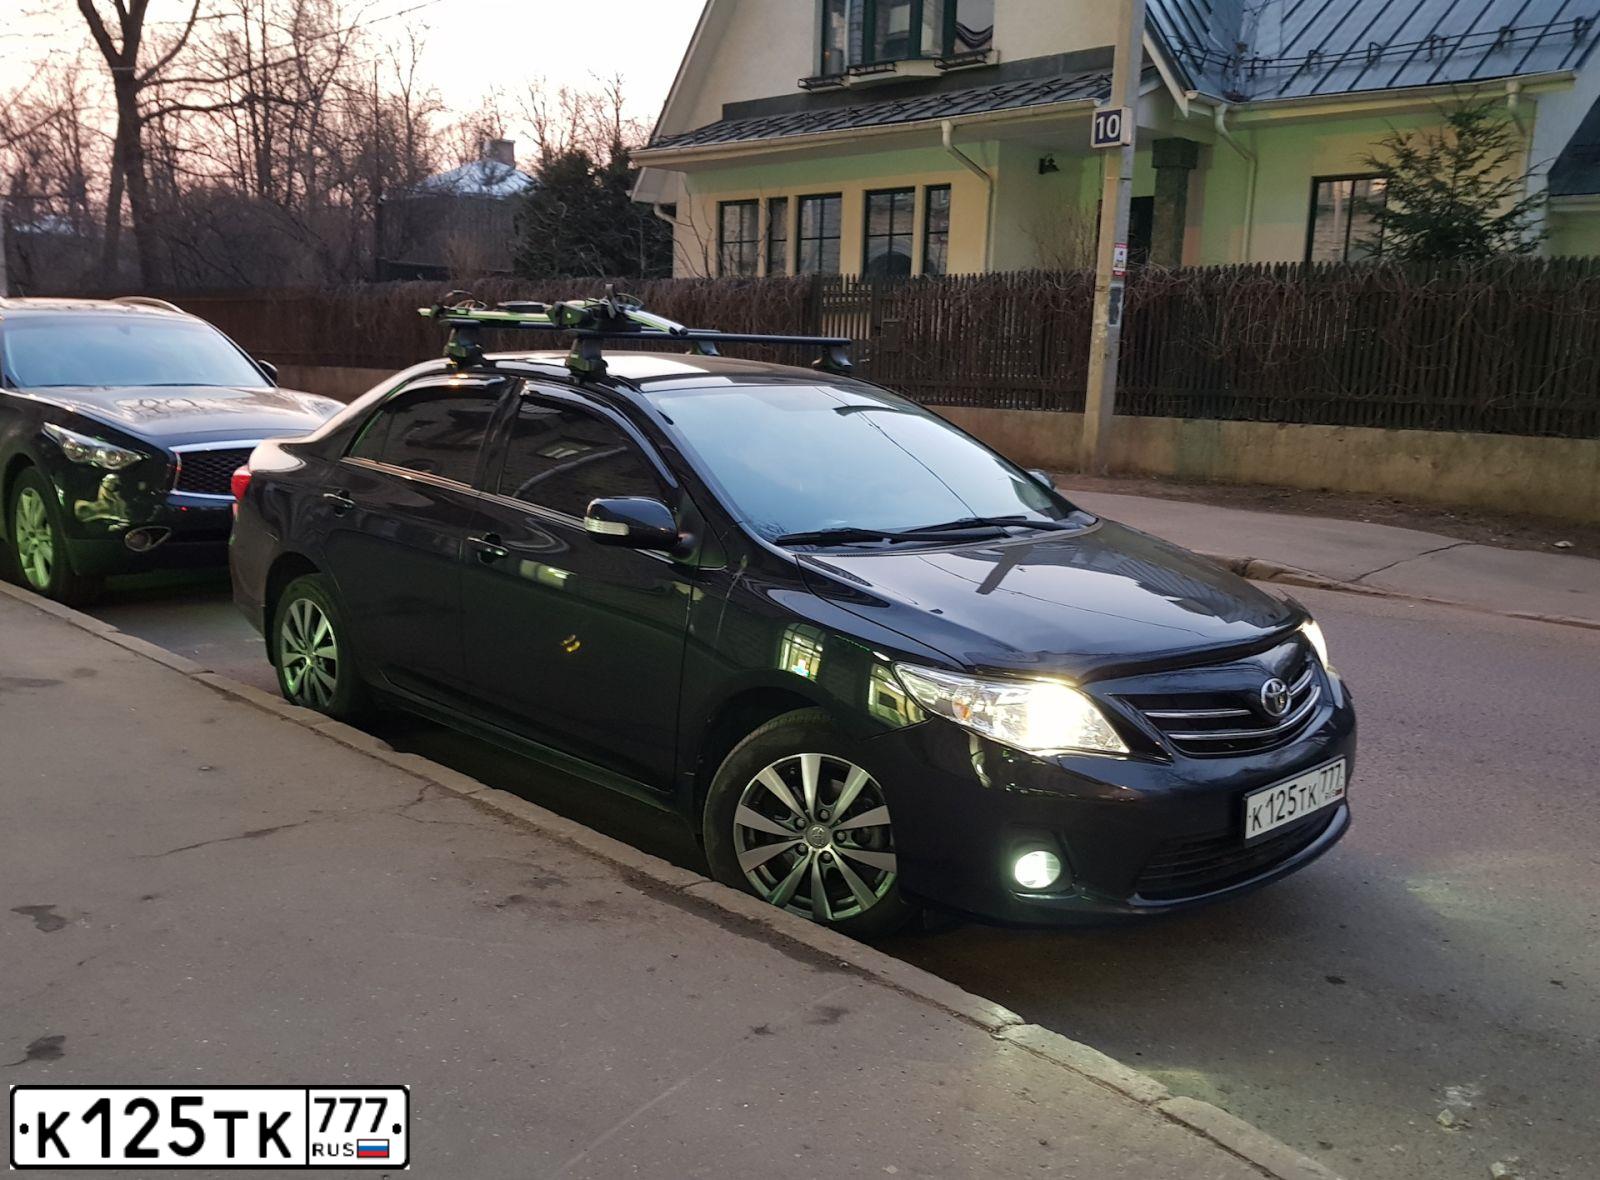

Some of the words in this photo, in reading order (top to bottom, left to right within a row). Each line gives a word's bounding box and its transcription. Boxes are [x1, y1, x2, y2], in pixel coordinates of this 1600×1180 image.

[1096, 114, 1120, 139] 10
[1251, 783, 1318, 832] K125TK
[1320, 763, 1341, 792] 777
